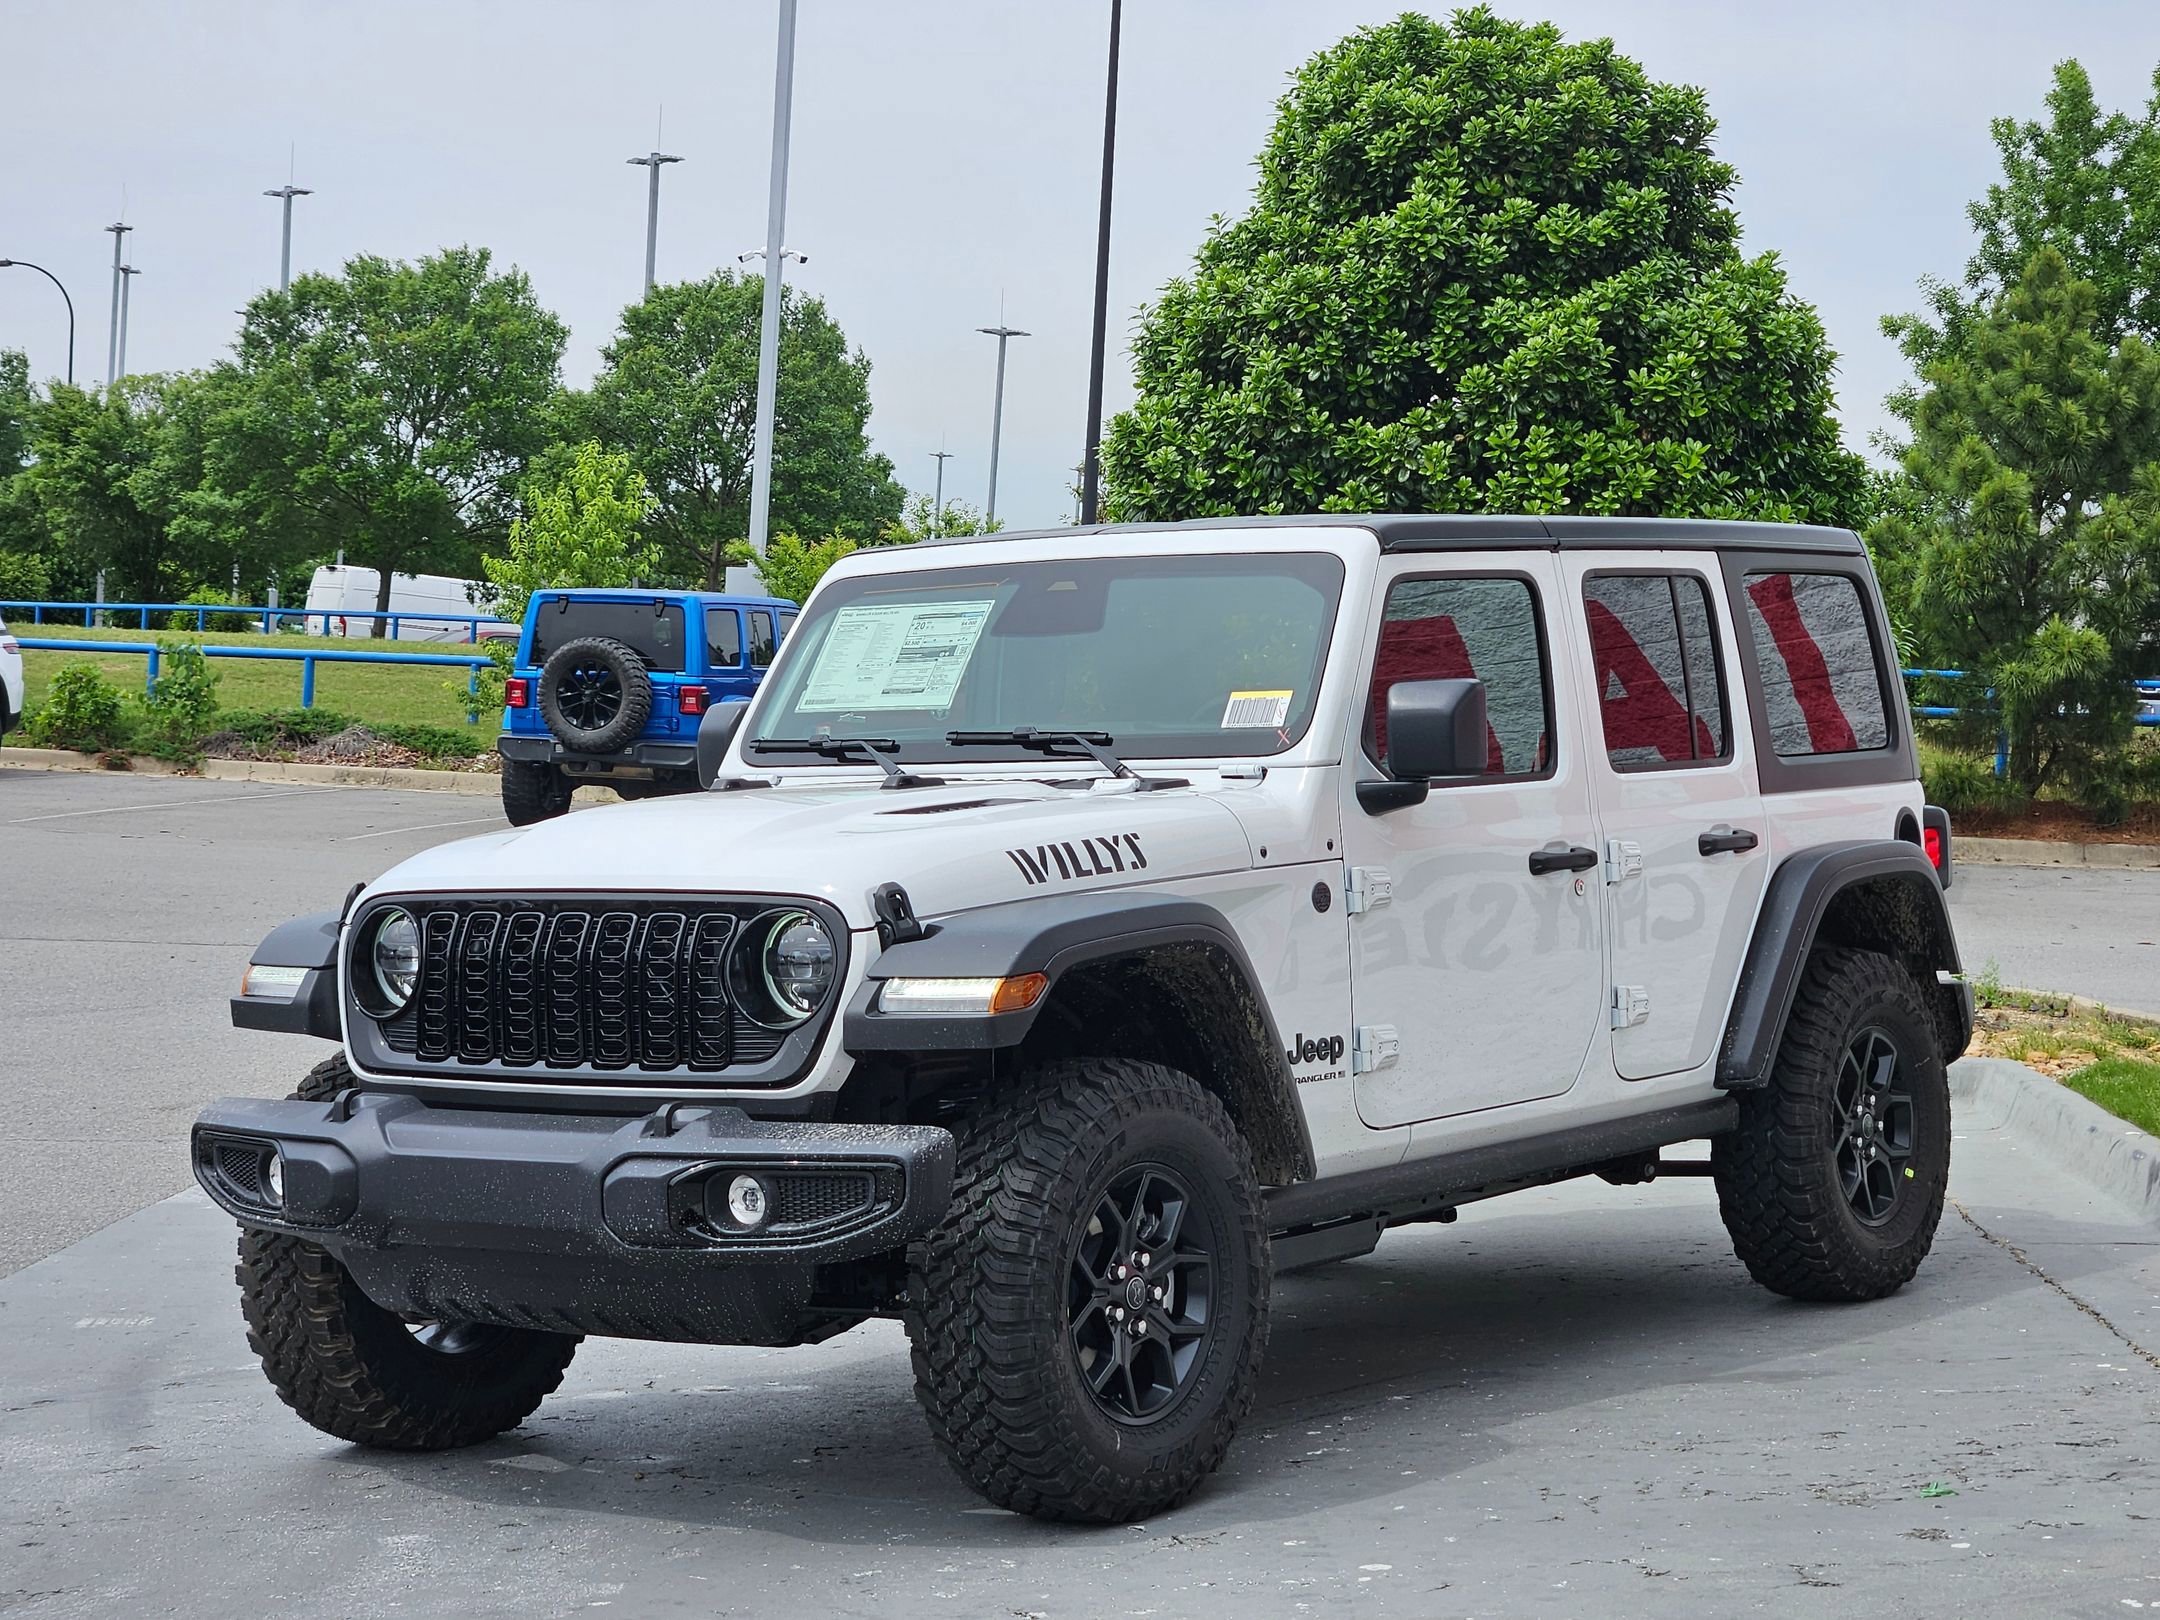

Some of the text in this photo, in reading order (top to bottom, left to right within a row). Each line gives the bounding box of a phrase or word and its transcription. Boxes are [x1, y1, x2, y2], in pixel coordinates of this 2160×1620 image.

[914, 621, 926, 630] 20
[1005, 832, 1147, 885] WILLYS
[1287, 1033, 1344, 1065] Jeep
[1295, 1072, 1337, 1084] RANGLER
